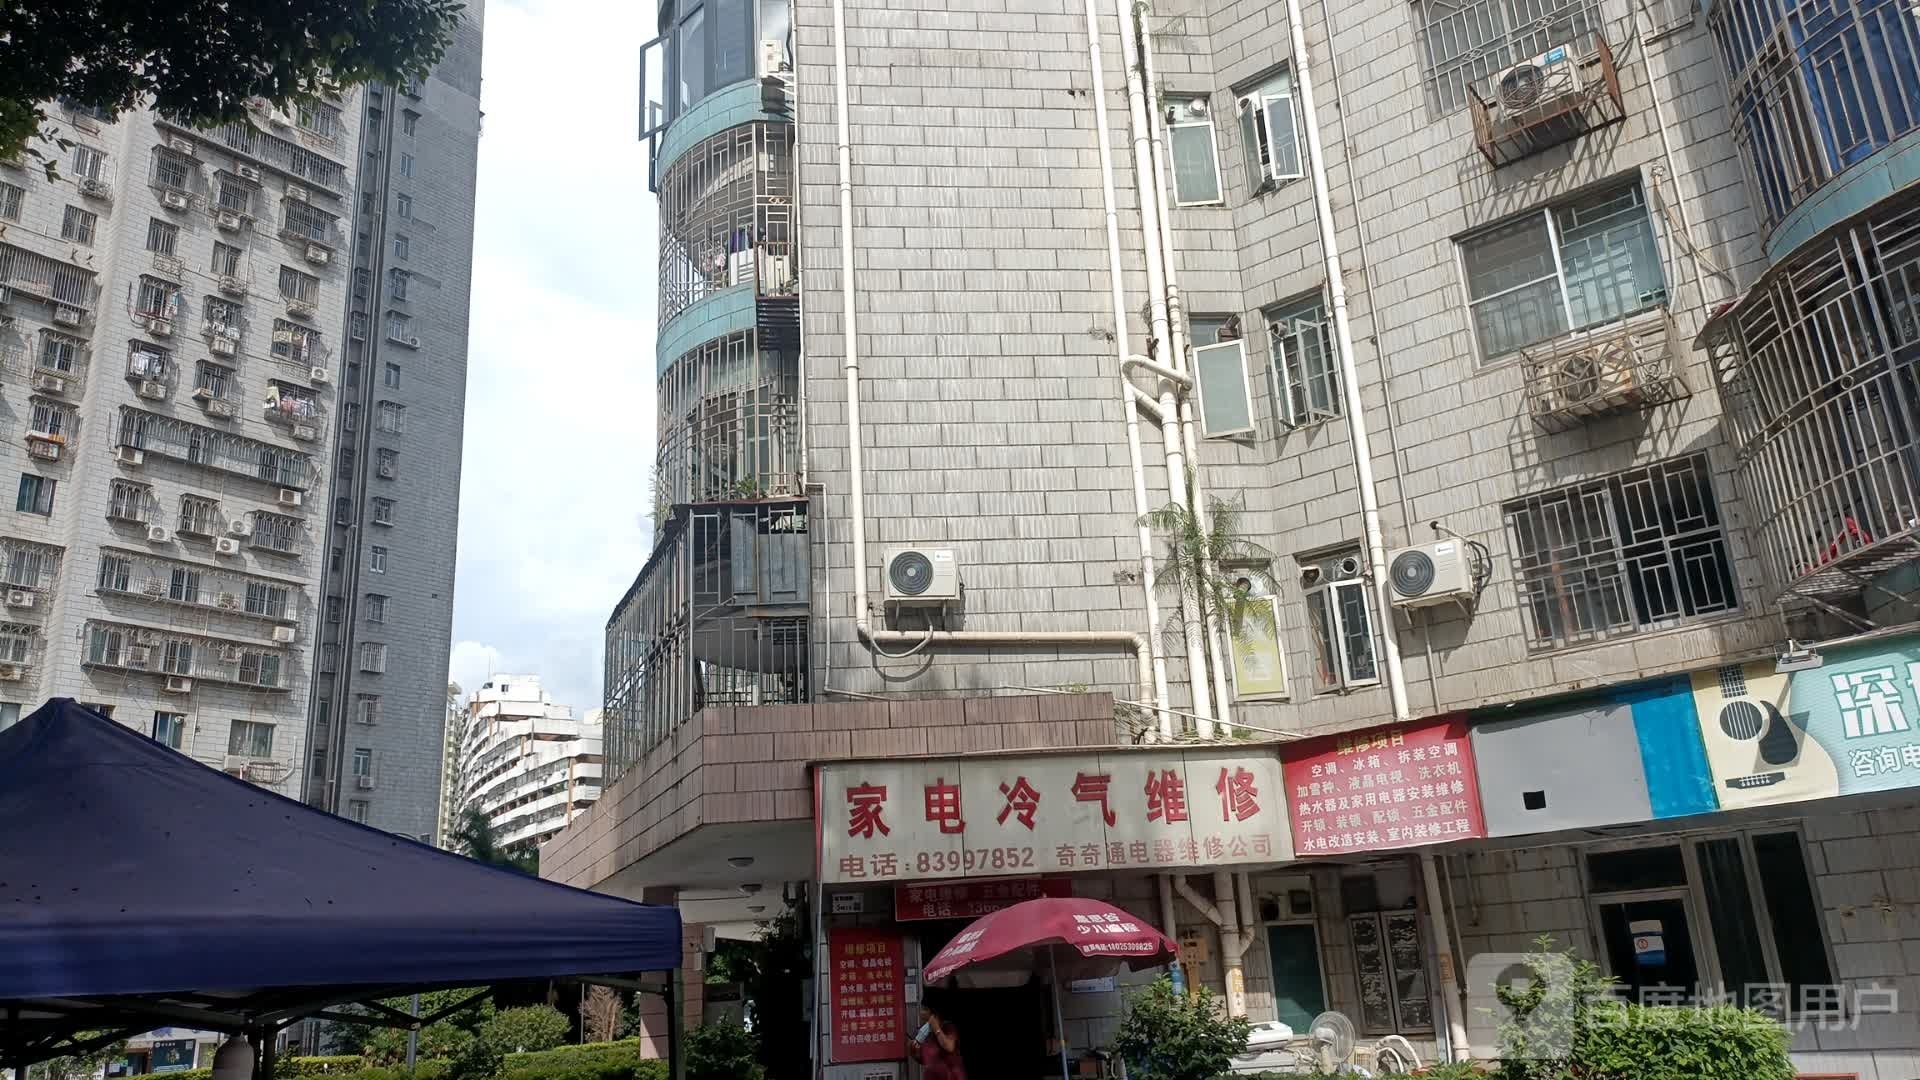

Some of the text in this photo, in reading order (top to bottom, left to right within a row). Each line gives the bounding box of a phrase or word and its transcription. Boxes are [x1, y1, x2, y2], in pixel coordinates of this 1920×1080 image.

[1829, 661, 1920, 740] 深
[846, 766, 1260, 839] 家电冷气维修
[1299, 780, 1465, 816] 热水器及家用电器安装维修
[1056, 834, 1273, 867] 奇奇通电器维修公司
[1077, 922, 1141, 934] 少儿编程
